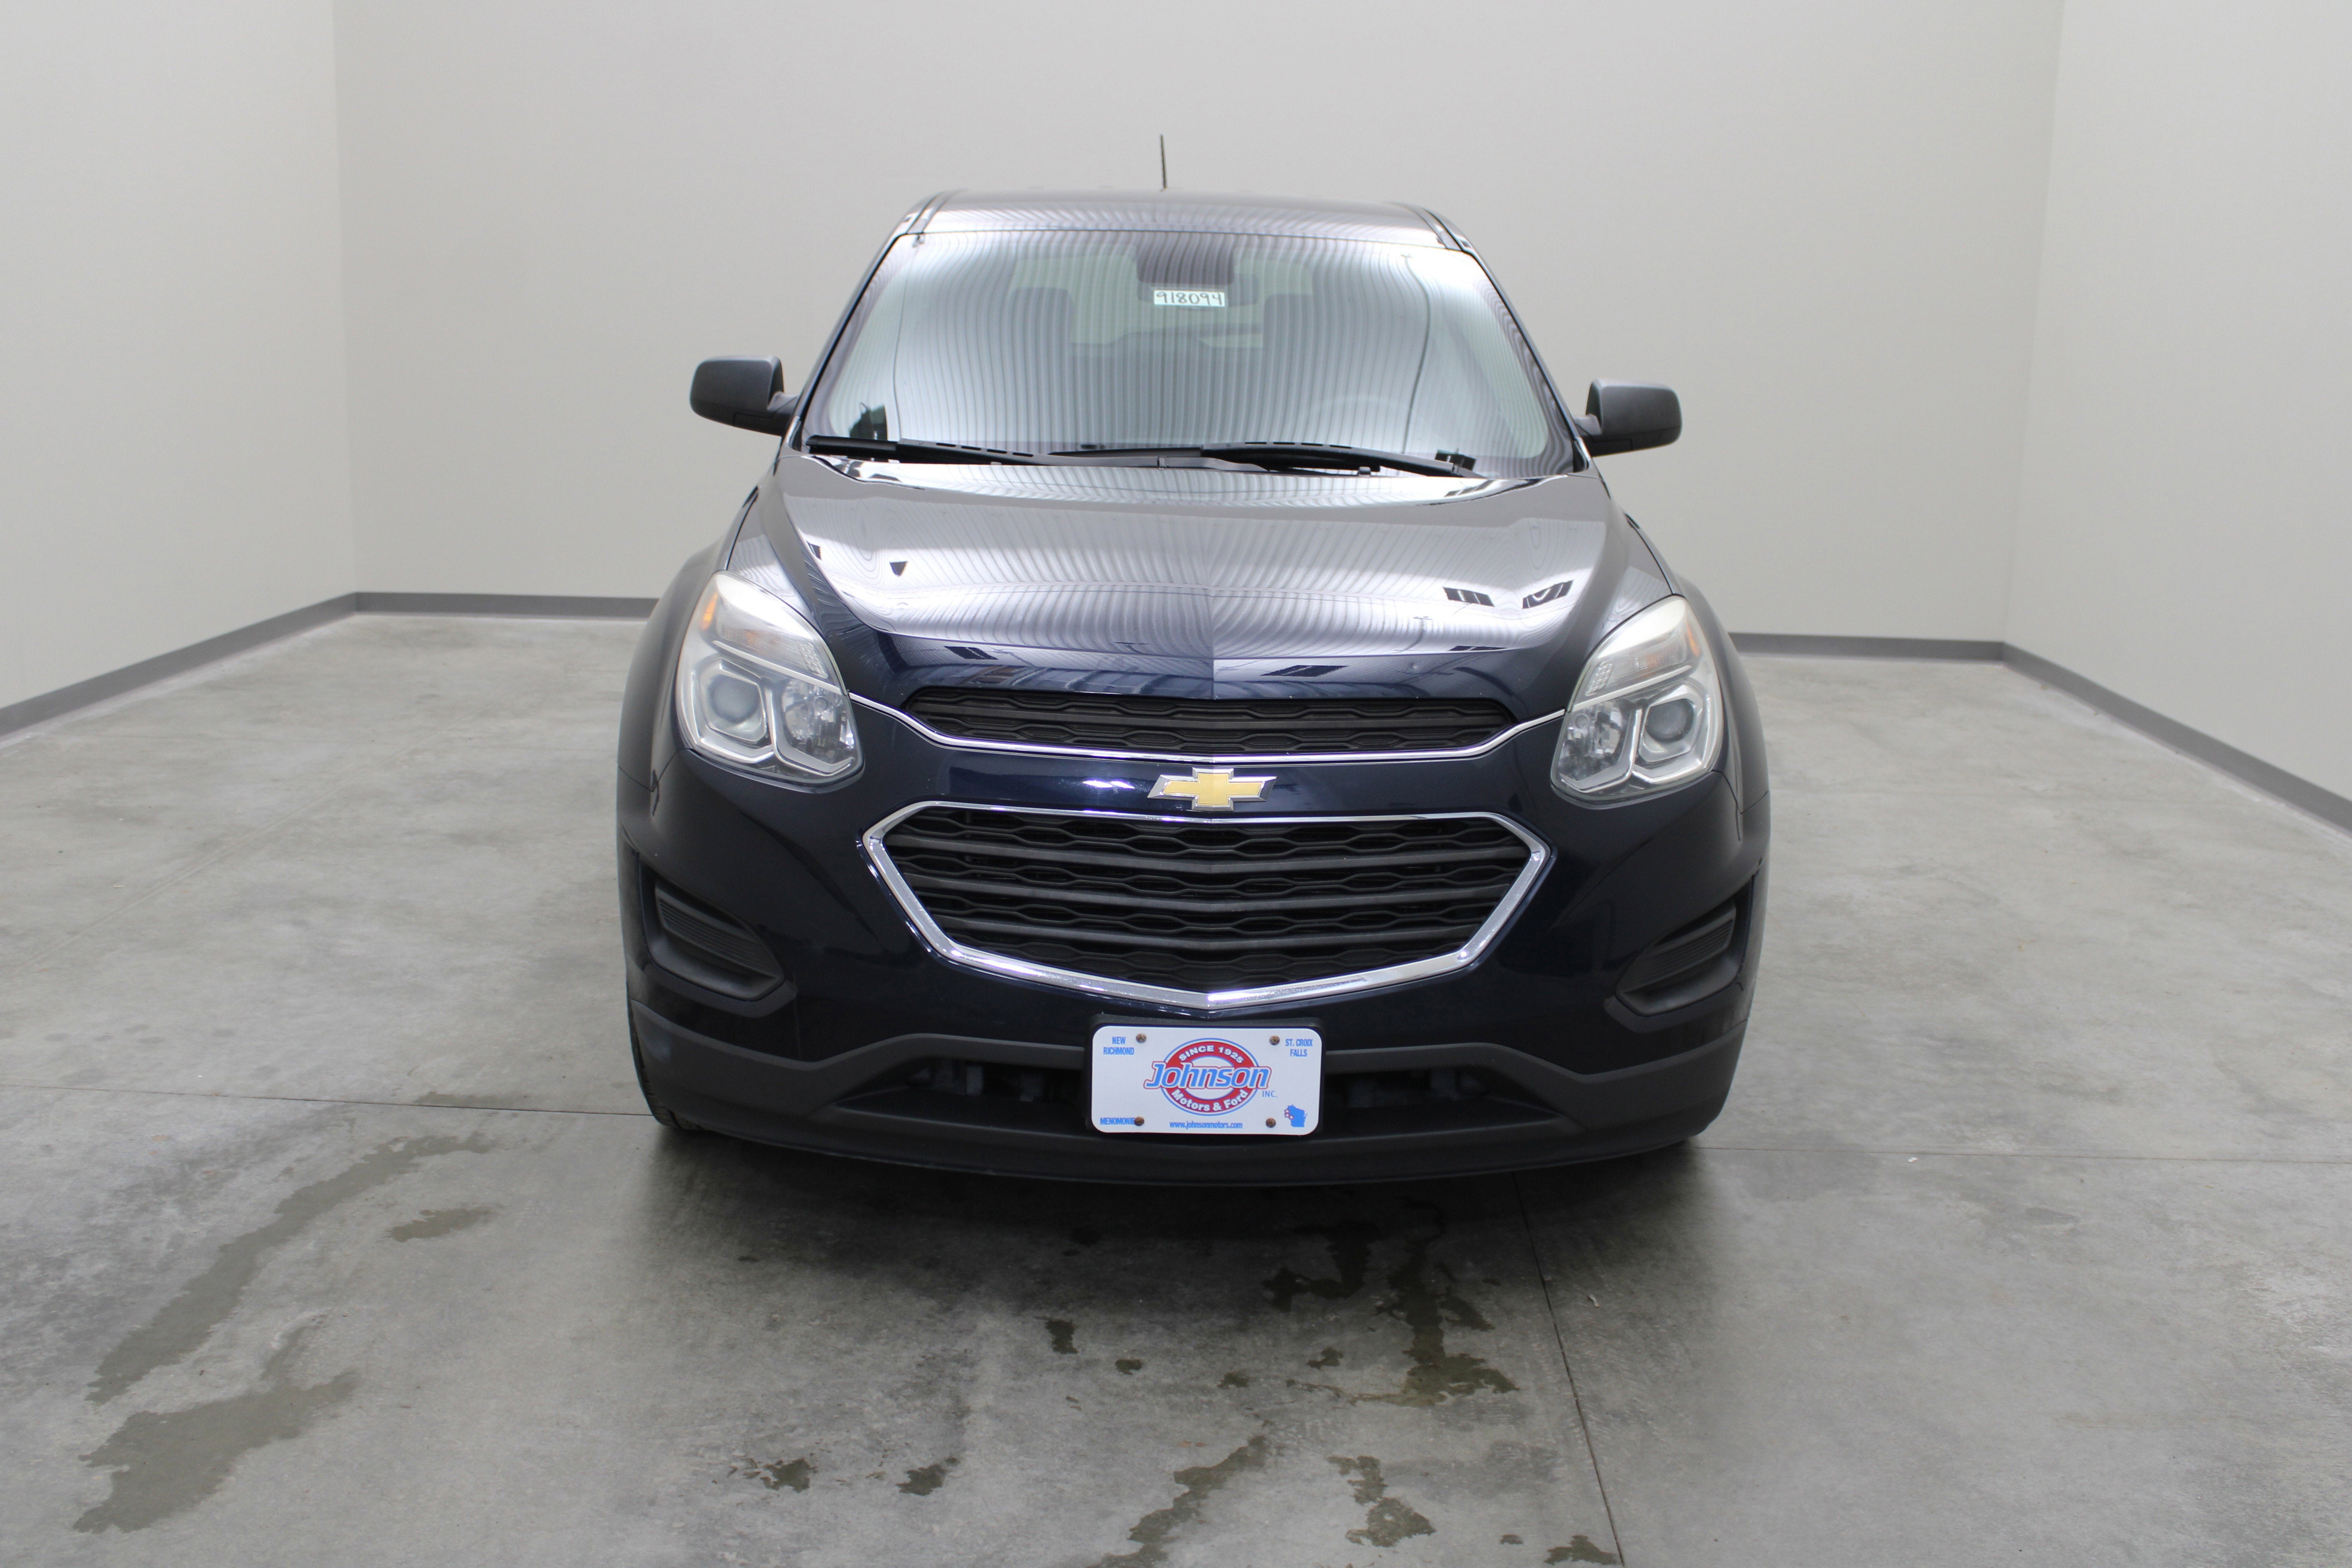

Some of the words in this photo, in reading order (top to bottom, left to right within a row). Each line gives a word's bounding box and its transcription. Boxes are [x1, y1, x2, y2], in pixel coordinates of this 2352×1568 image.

[1156, 292, 1222, 305] 918094
[1103, 1047, 1134, 1055] RICHMOND
[1178, 1045, 1214, 1061] SINCE
[1218, 1047, 1244, 1063] 1925
[1145, 1062, 1271, 1089] Johnson
[1171, 1089, 1210, 1111] Motors
[1212, 1102, 1222, 1111] &
[1223, 1089, 1249, 1109] Ford
[1169, 1121, 1243, 1129] www.johnsonmotors.com
